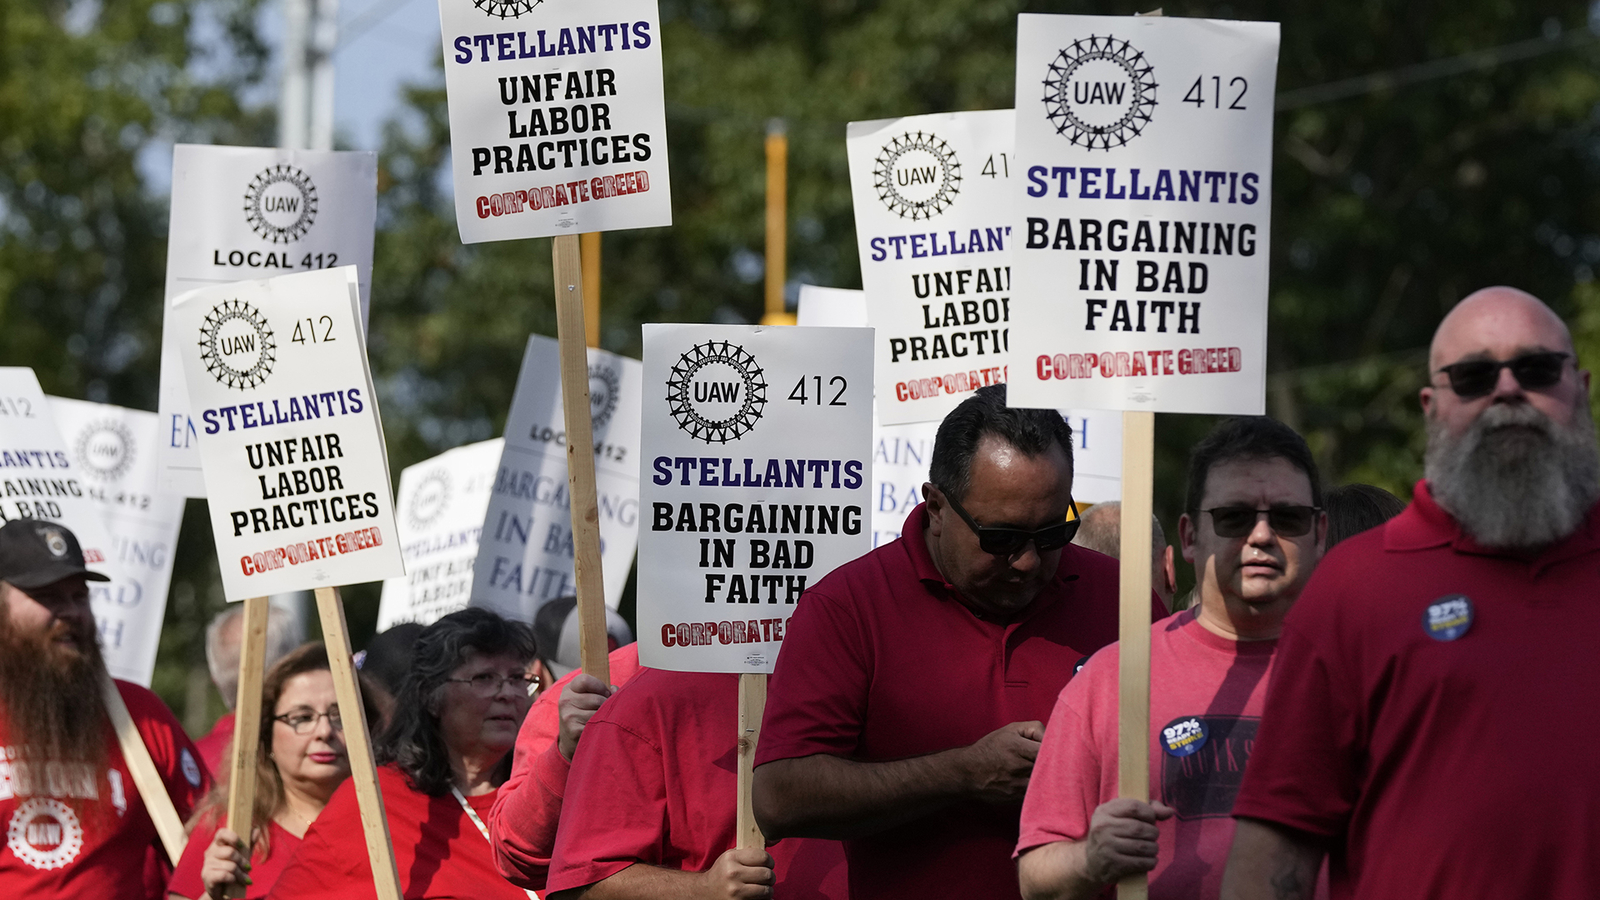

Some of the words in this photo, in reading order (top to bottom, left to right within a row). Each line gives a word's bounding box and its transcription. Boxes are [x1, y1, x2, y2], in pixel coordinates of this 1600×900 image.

[454, 21, 651, 64] STELLANTIS
[498, 68, 617, 105] UNFAIR
[1074, 81, 1126, 105] UAW
[1182, 75, 1248, 110] 412
[508, 103, 611, 138] LABOR
[472, 133, 651, 176] PRACTICES
[981, 153, 1010, 179] 41
[897, 165, 936, 187] UAW
[1027, 165, 1259, 205] STELLANTIS
[264, 196, 300, 214] UAW
[476, 180, 590, 219] CORPORATE
[590, 170, 650, 200] GREED
[870, 226, 1011, 262] STELLAN
[1026, 217, 1256, 256] BARGAINING
[213, 249, 294, 269] LOCAL
[301, 252, 338, 270] 412
[1079, 259, 1119, 291] IN
[1136, 260, 1209, 294] BAD
[291, 315, 336, 345] 412
[1085, 299, 1201, 334] FAITH
[221, 334, 256, 357] UAW
[890, 328, 1009, 363] PRACTI
[1036, 350, 1173, 381] CORPORATE
[1177, 347, 1242, 374] GREED
[694, 381, 741, 403] UAW
[788, 374, 847, 406] 412
[202, 388, 364, 435] STELLANTIS
[245, 433, 344, 470] UNFAIR
[530, 423, 567, 446] LOC
[0, 478, 82, 498] AINING
[258, 465, 344, 500] LABOR
[652, 456, 863, 490] STELLANTIS
[15, 501, 62, 519] BAD
[230, 492, 379, 537] PRACTICES
[652, 502, 862, 535] BARGAINING
[240, 535, 336, 577] CORPORATE
[335, 526, 383, 556] GREED
[494, 510, 534, 545] IN
[544, 524, 606, 560] BA
[699, 538, 736, 568] IN
[749, 539, 814, 569] BAD
[704, 574, 807, 604] FAITH
[661, 618, 783, 648] CORPORATE
[1164, 718, 1200, 739] 97%
